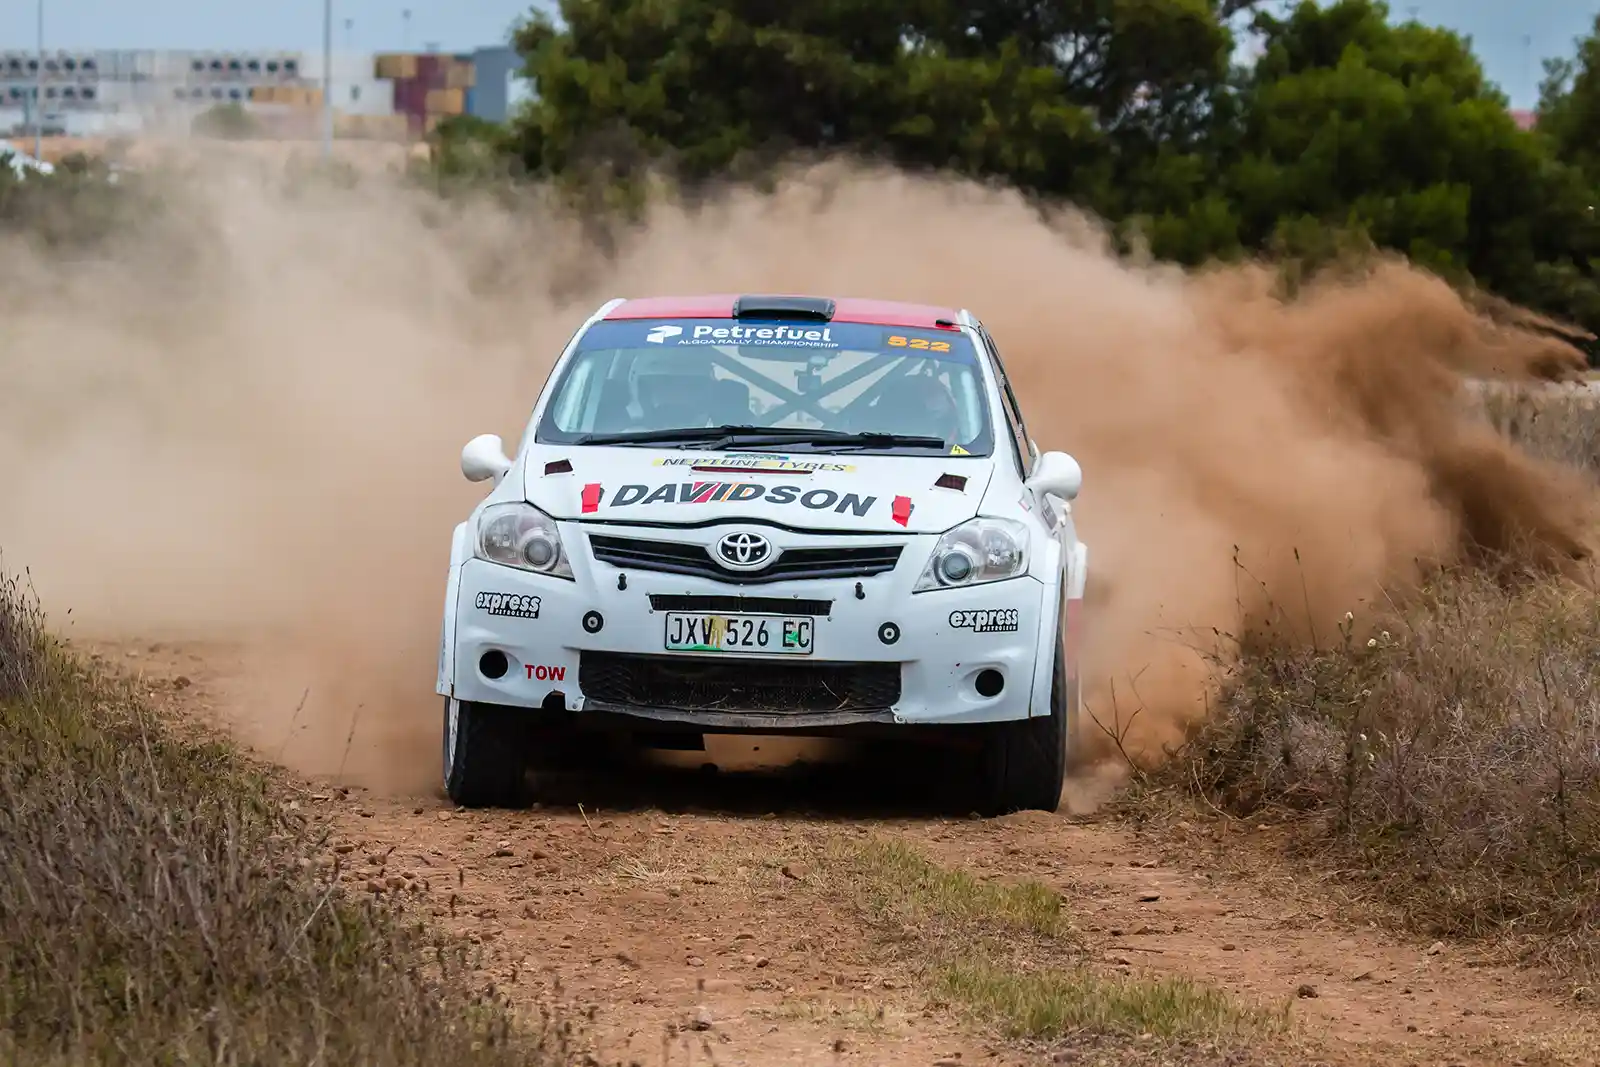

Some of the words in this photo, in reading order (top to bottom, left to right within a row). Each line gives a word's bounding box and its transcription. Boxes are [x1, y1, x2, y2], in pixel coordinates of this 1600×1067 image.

[693, 325, 831, 342] Petrefuel
[754, 339, 839, 348] CHAMPIONSHIP
[887, 334, 950, 352] 522
[662, 457, 763, 468] NEPTUNE
[777, 461, 847, 472] TYRES
[609, 482, 878, 517] DAVIDSON
[475, 591, 541, 614] express
[949, 609, 1019, 632] express
[670, 617, 714, 646] JXV
[726, 619, 769, 647] 526
[782, 620, 810, 648] EC
[525, 663, 565, 681] TOW
